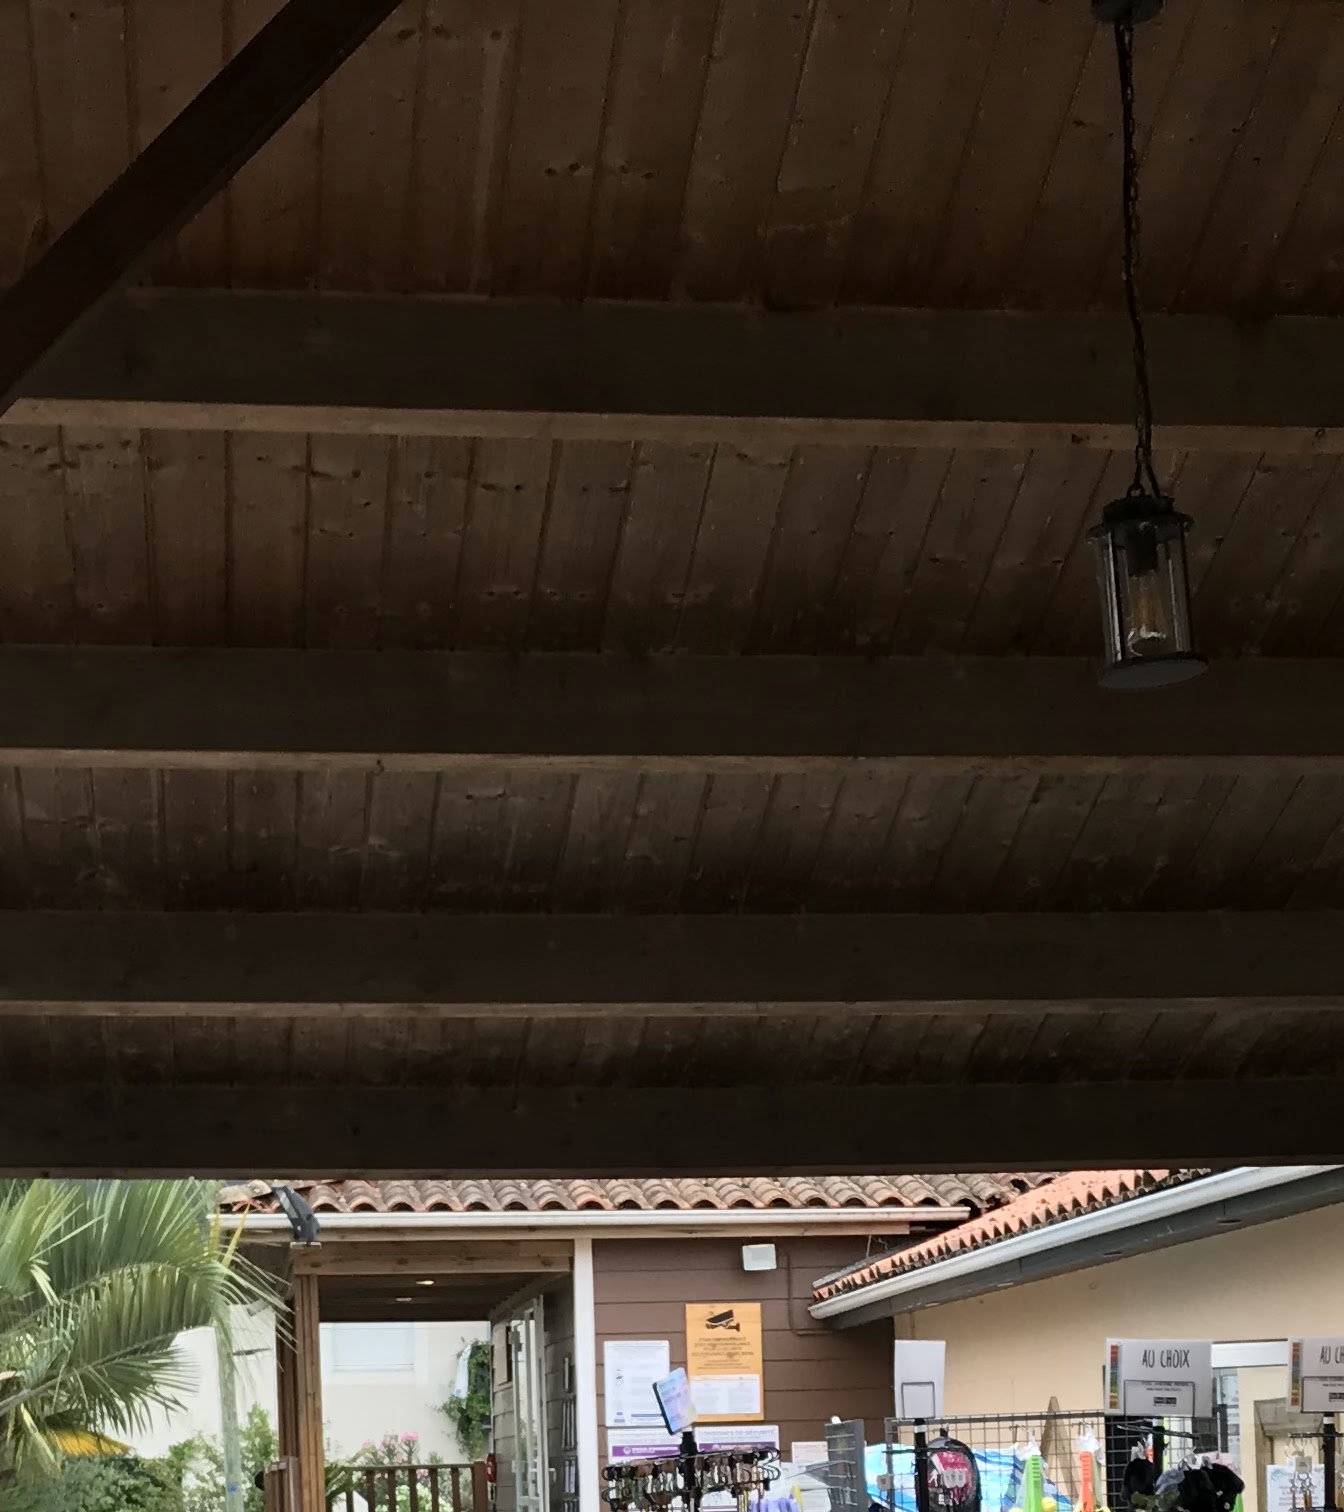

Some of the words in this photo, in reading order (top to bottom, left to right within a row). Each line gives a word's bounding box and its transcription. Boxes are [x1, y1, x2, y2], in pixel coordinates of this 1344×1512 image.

[1142, 1349, 1155, 1368] AU
[1160, 1349, 1190, 1368] CHOIX
[1319, 1346, 1331, 1364] AU
